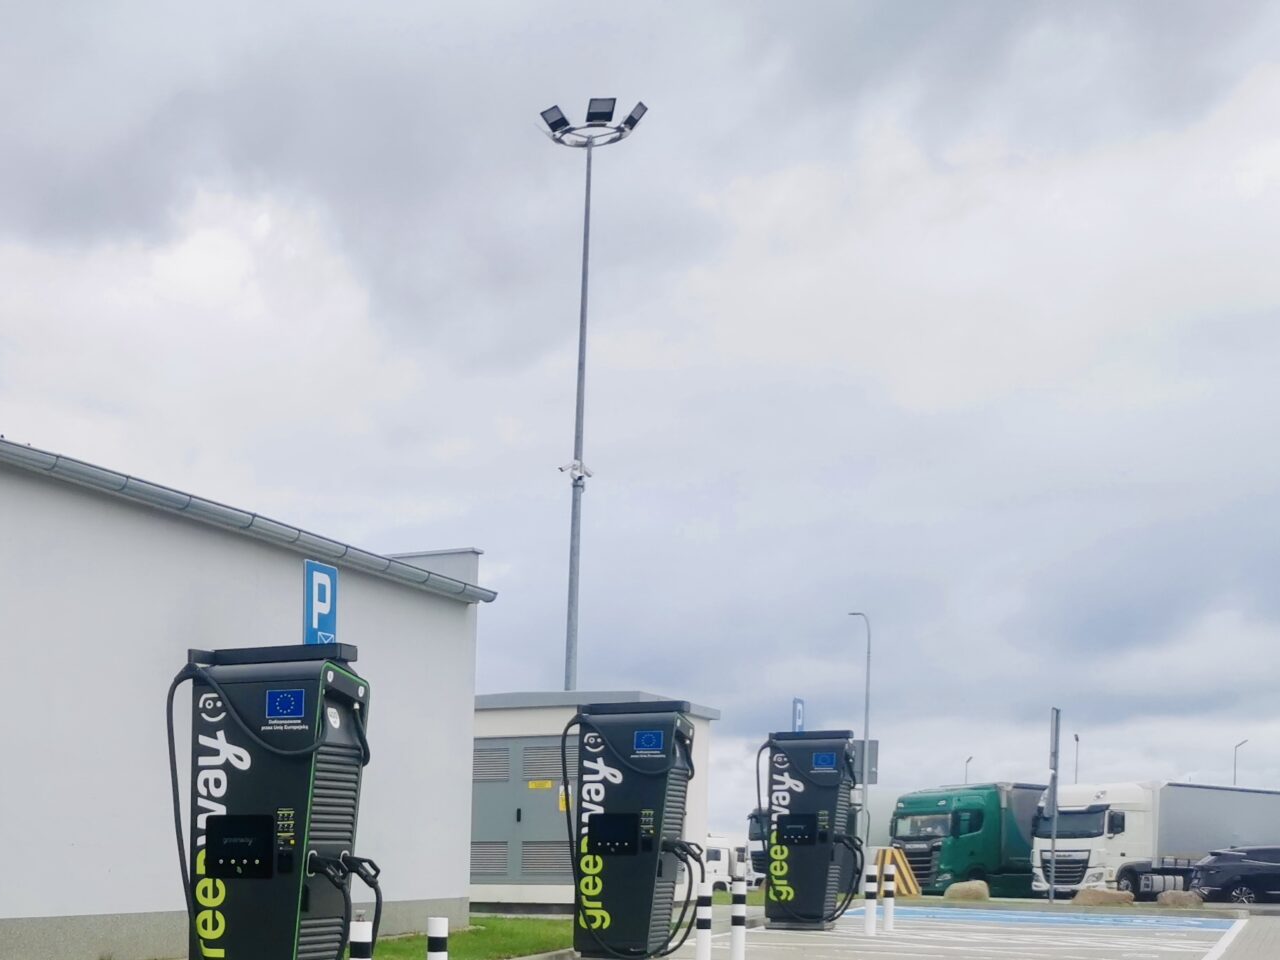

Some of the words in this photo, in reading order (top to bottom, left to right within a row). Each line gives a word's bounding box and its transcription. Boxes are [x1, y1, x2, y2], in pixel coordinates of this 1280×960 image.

[313, 571, 332, 629] P
[579, 757, 623, 930] greeway
[769, 772, 804, 901] greeway
